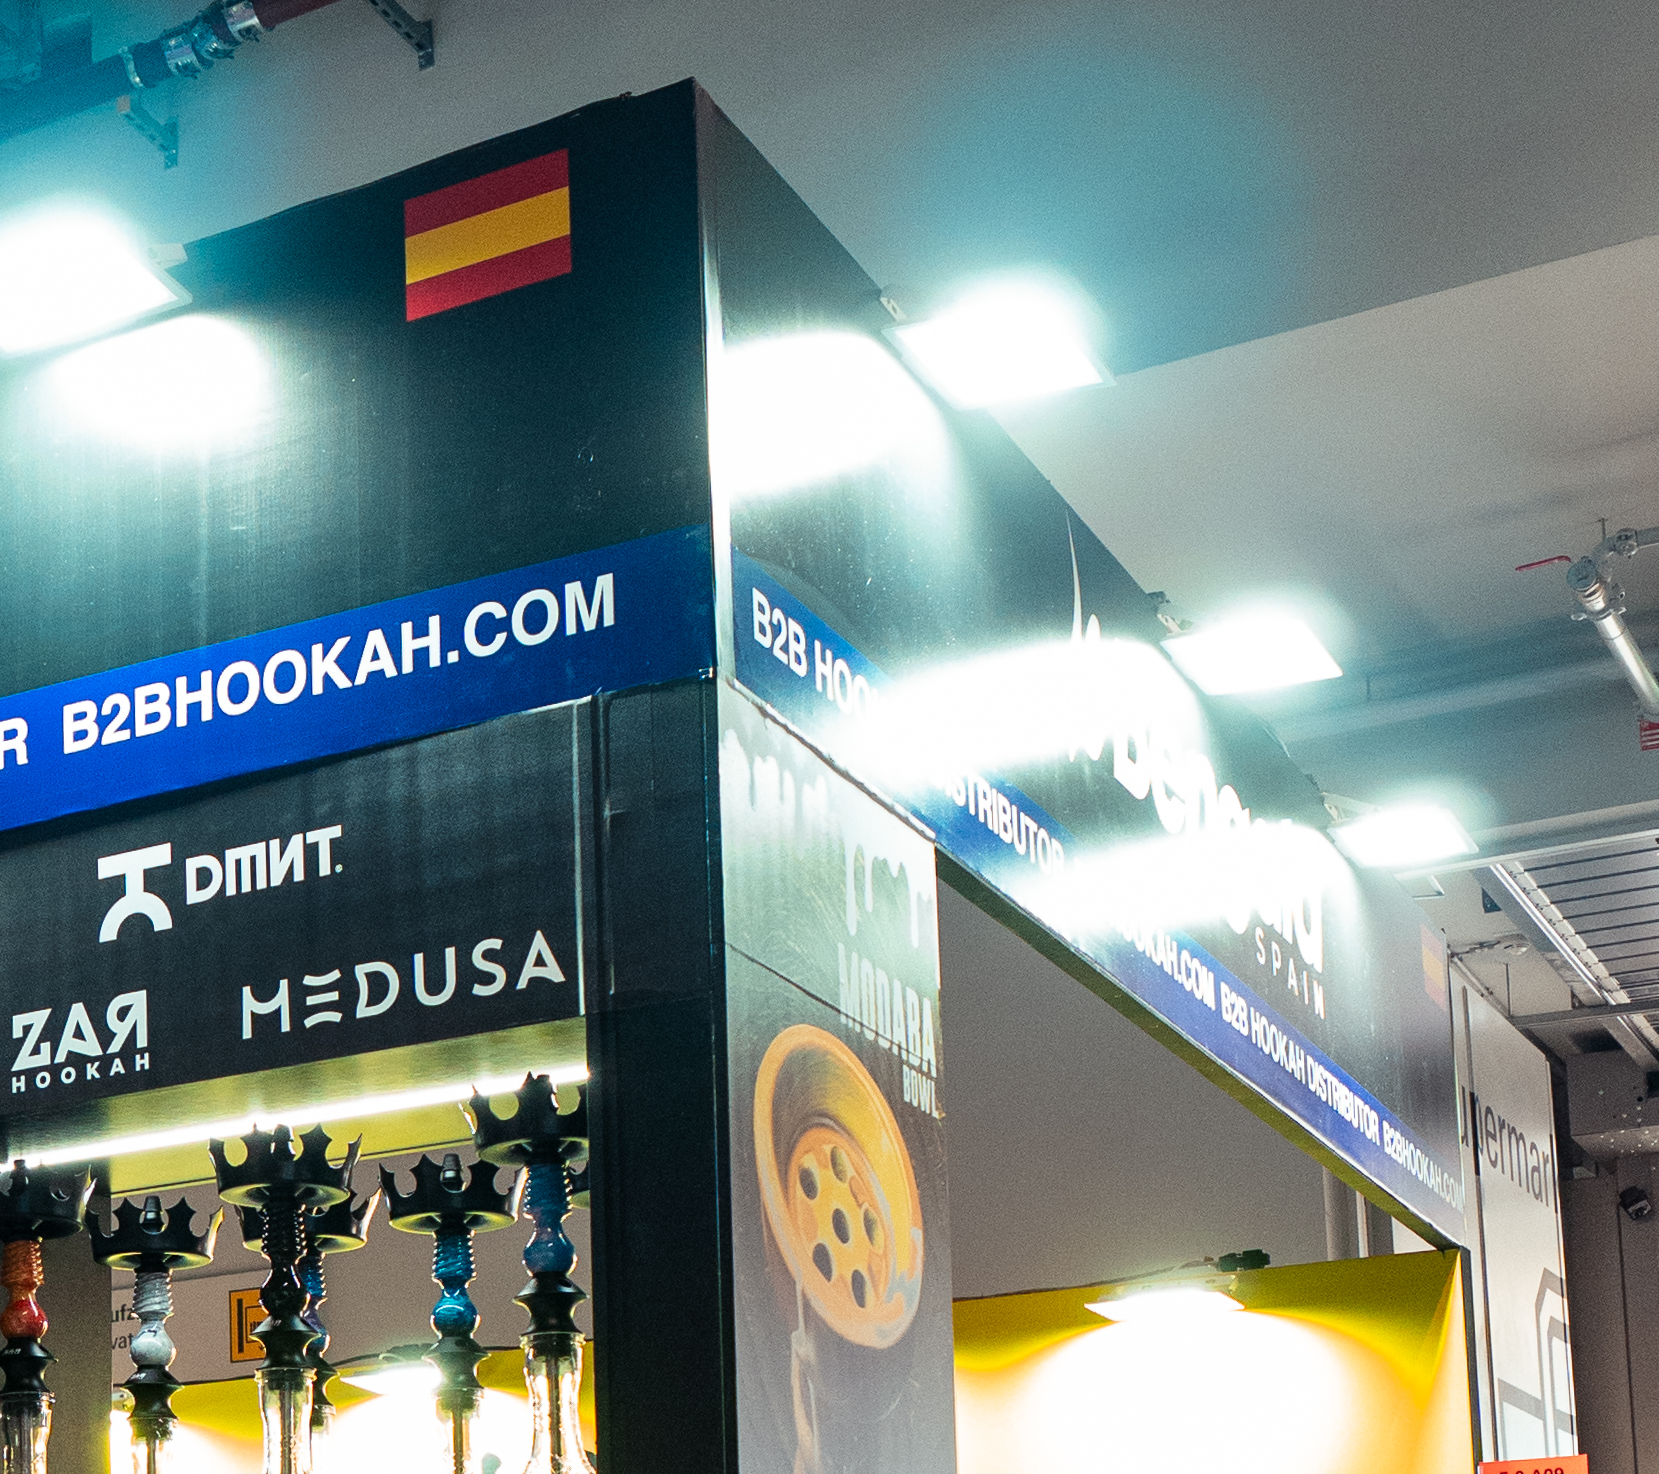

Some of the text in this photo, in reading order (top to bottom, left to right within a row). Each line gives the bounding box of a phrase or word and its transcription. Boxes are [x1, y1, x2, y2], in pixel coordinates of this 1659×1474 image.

[62, 573, 616, 755] B2BHOOKAH.COM
[752, 587, 808, 677] B2B
[944, 769, 1064, 874] STRIBUTOR
[1220, 981, 1249, 1037] B2B
[1249, 1006, 1306, 1085] HOOKAH
[1306, 1054, 1381, 1146] DISTRIBUTOR
[1382, 1120, 1464, 1212] B2BHOOKAH.COM
[242, 928, 566, 1039] MEDUSA
[838, 941, 937, 1078] MODABA
[1255, 927, 1326, 1020] SPAIN
[11, 1052, 150, 1094] HOOKAH
[902, 1063, 940, 1119] BOWL
